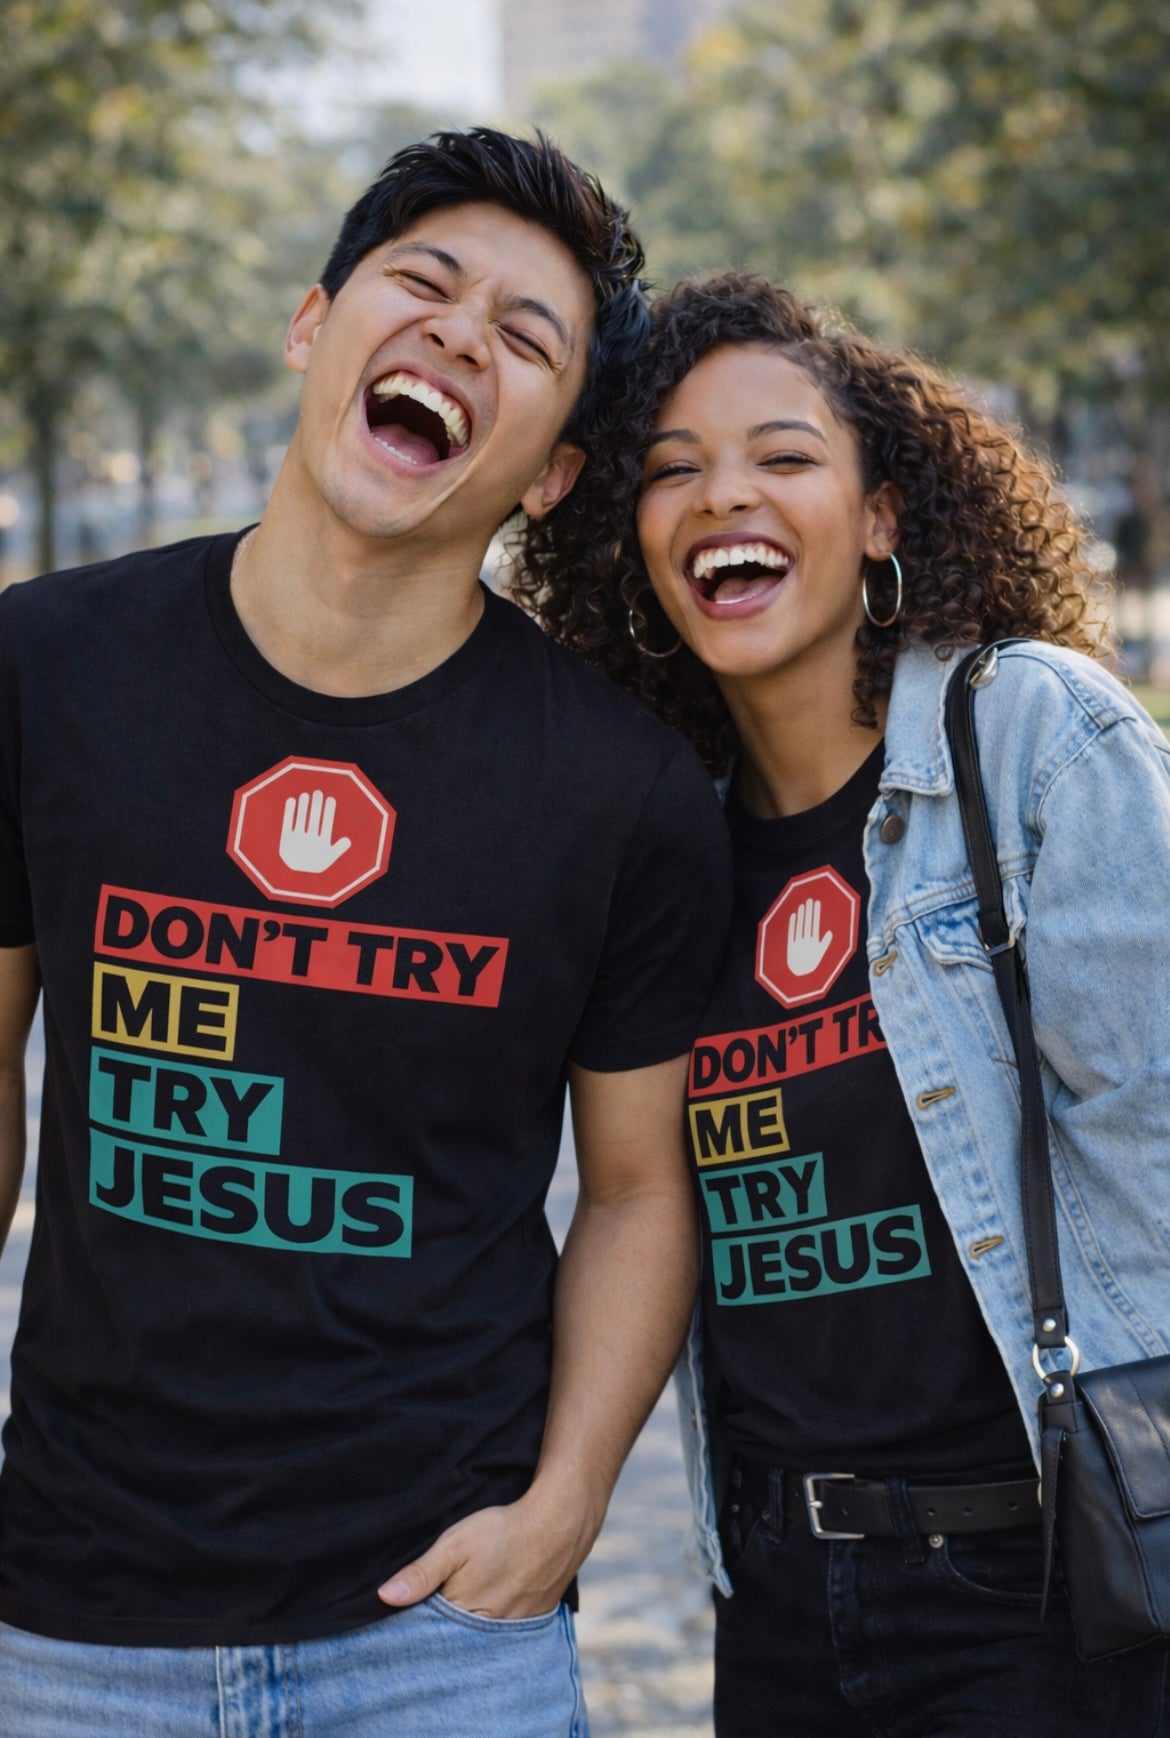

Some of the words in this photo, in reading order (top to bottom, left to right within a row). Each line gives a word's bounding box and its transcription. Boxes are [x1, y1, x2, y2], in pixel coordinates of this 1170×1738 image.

[102, 895, 329, 977] DON'T
[347, 931, 500, 997] TRY
[100, 972, 230, 1052] ME
[693, 1017, 823, 1089] DON'T
[832, 1000, 886, 1054] TR
[98, 1056, 275, 1143] TRY
[695, 1096, 783, 1159] ME
[95, 1145, 405, 1248] JESUS
[705, 1159, 818, 1225] TRY
[720, 1215, 922, 1299] JESUS
